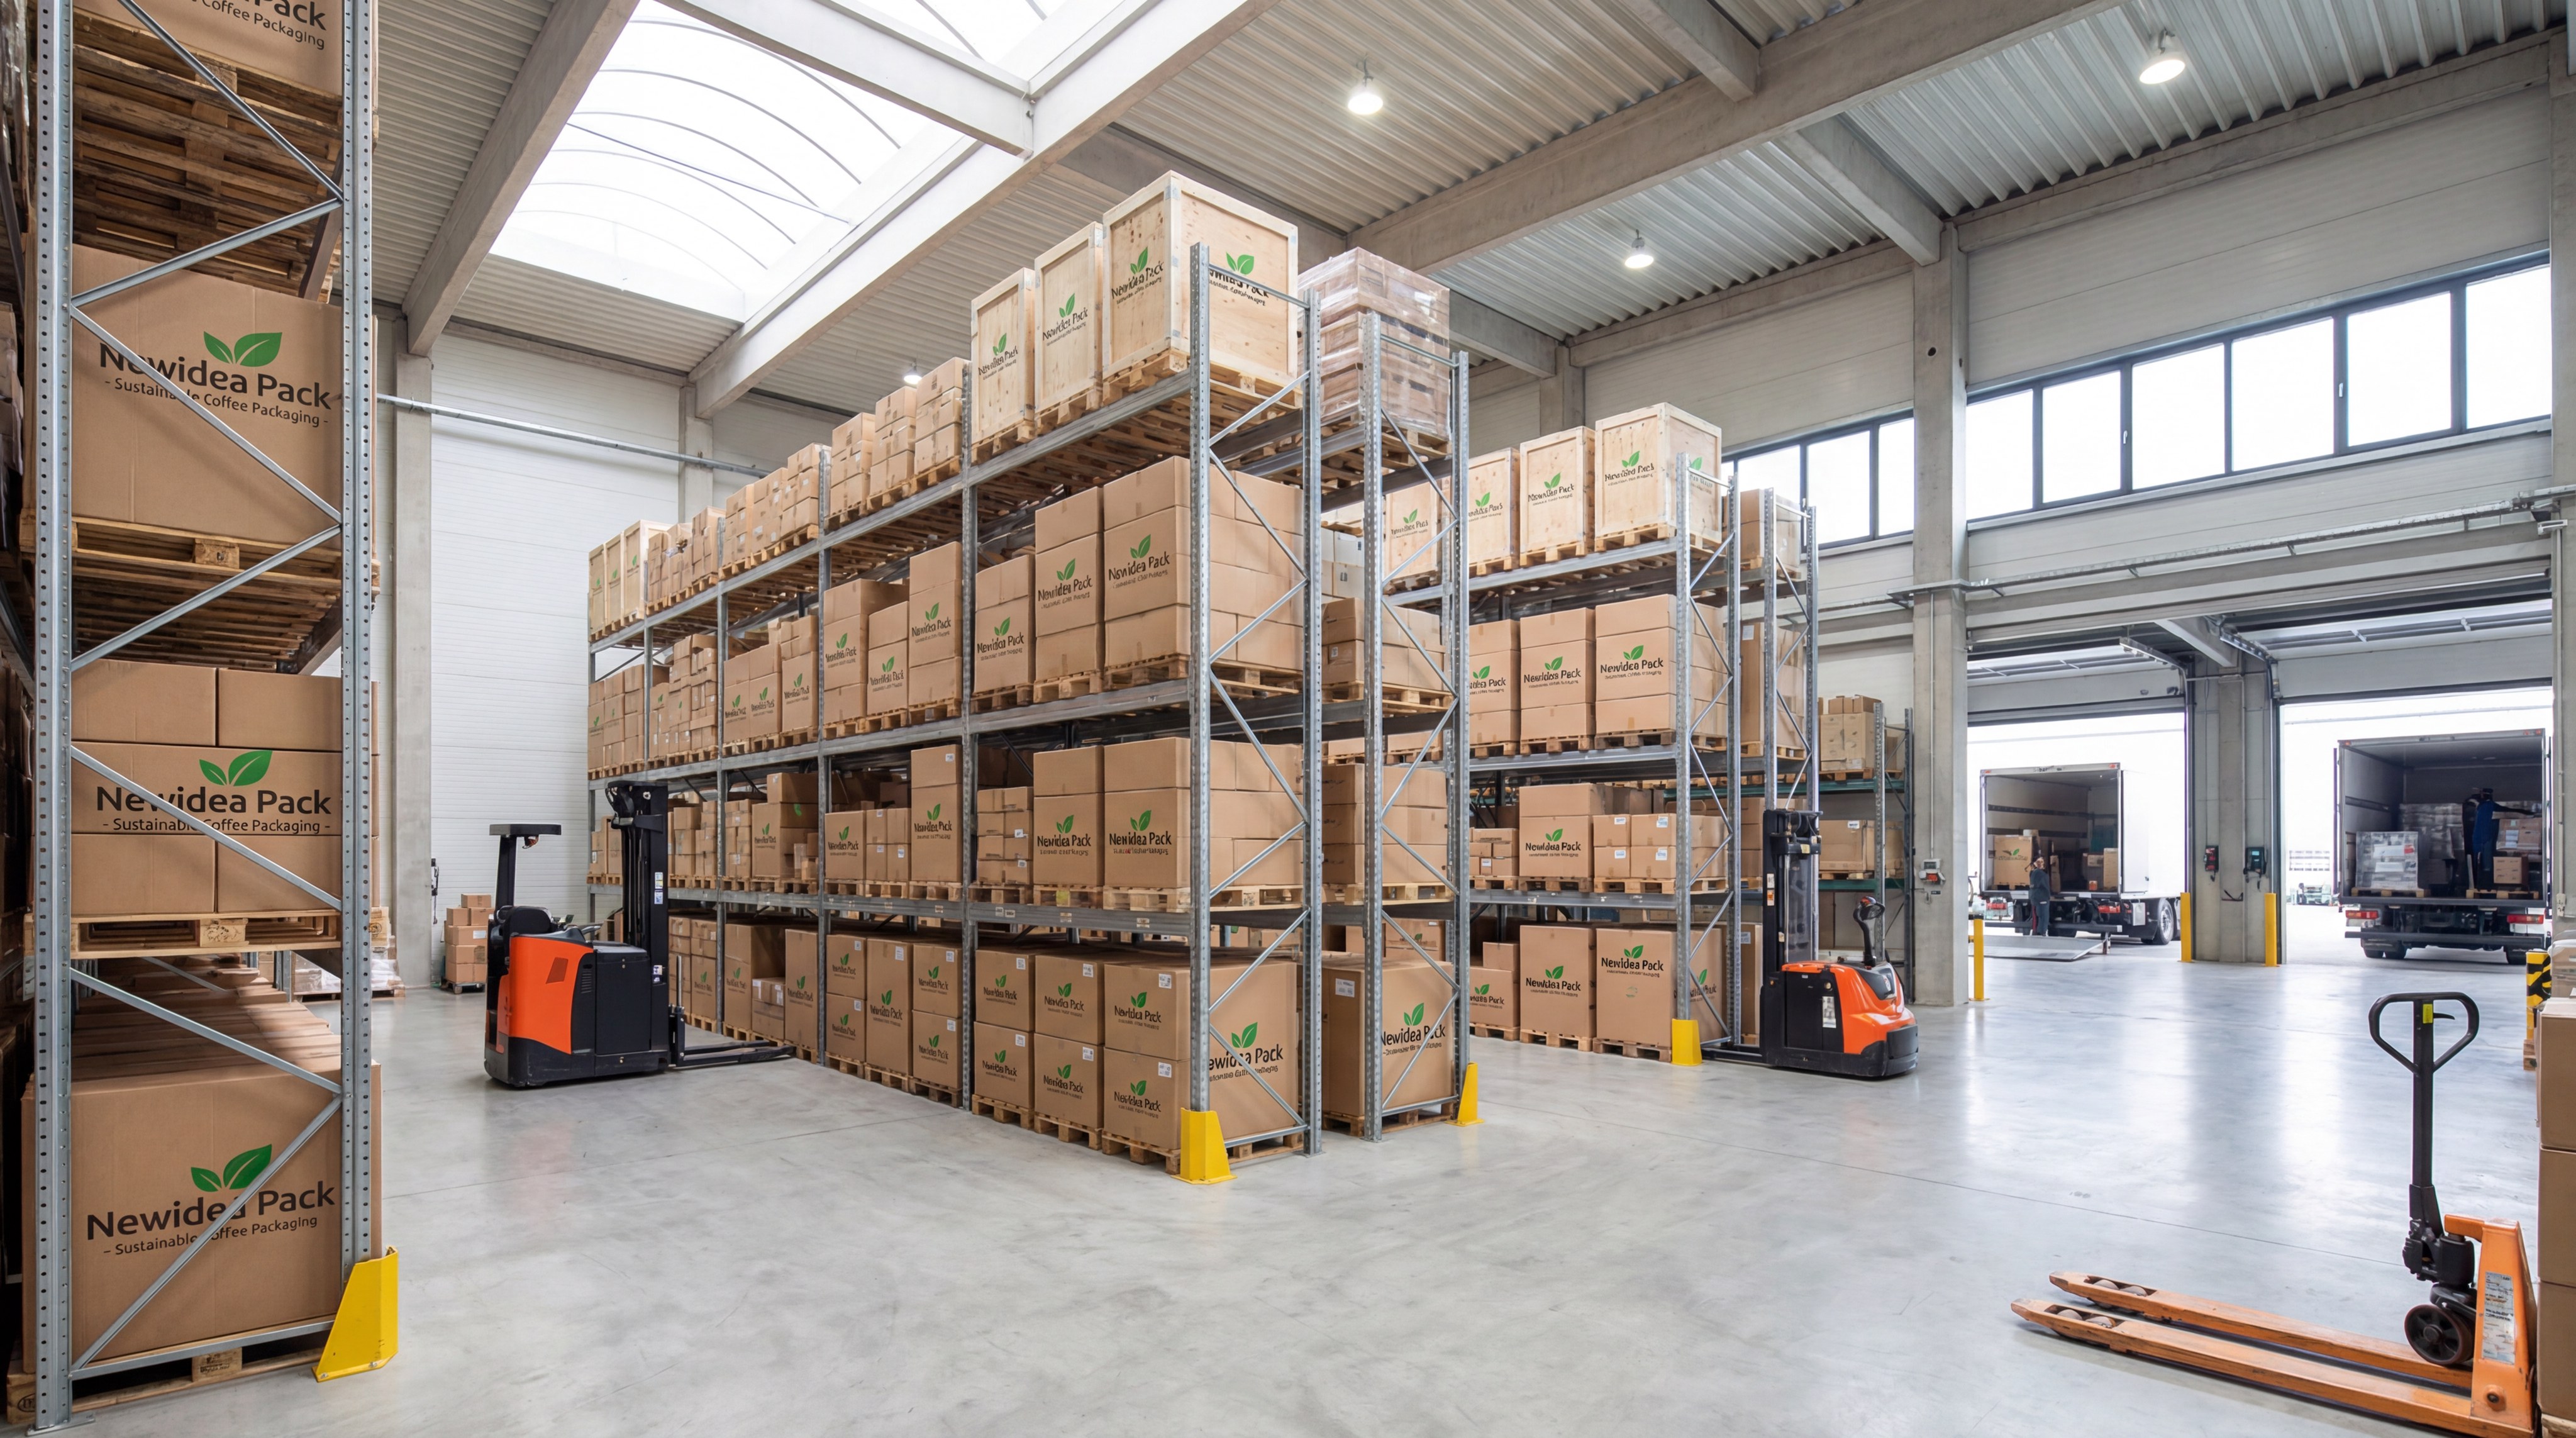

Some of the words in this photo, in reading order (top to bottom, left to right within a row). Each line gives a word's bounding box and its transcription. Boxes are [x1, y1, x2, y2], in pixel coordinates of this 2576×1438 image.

[255, 0, 326, 31] ack
[254, 13, 325, 50] Packaging
[258, 373, 331, 410] Pack
[204, 394, 248, 412] Coffee
[252, 403, 319, 428] Packaging
[258, 789, 331, 814] Pack
[252, 819, 320, 834] Packaging
[1149, 830, 1172, 845] Pack
[1072, 833, 1092, 847] Pack
[1562, 981, 1581, 991] Pack
[1381, 1027, 1421, 1046] Newidea
[1424, 1024, 1446, 1040] Pck
[1255, 1044, 1284, 1064] Pack
[258, 1181, 335, 1215] Pack
[211, 1226, 248, 1240] offee
[252, 1217, 318, 1235] Packaging
